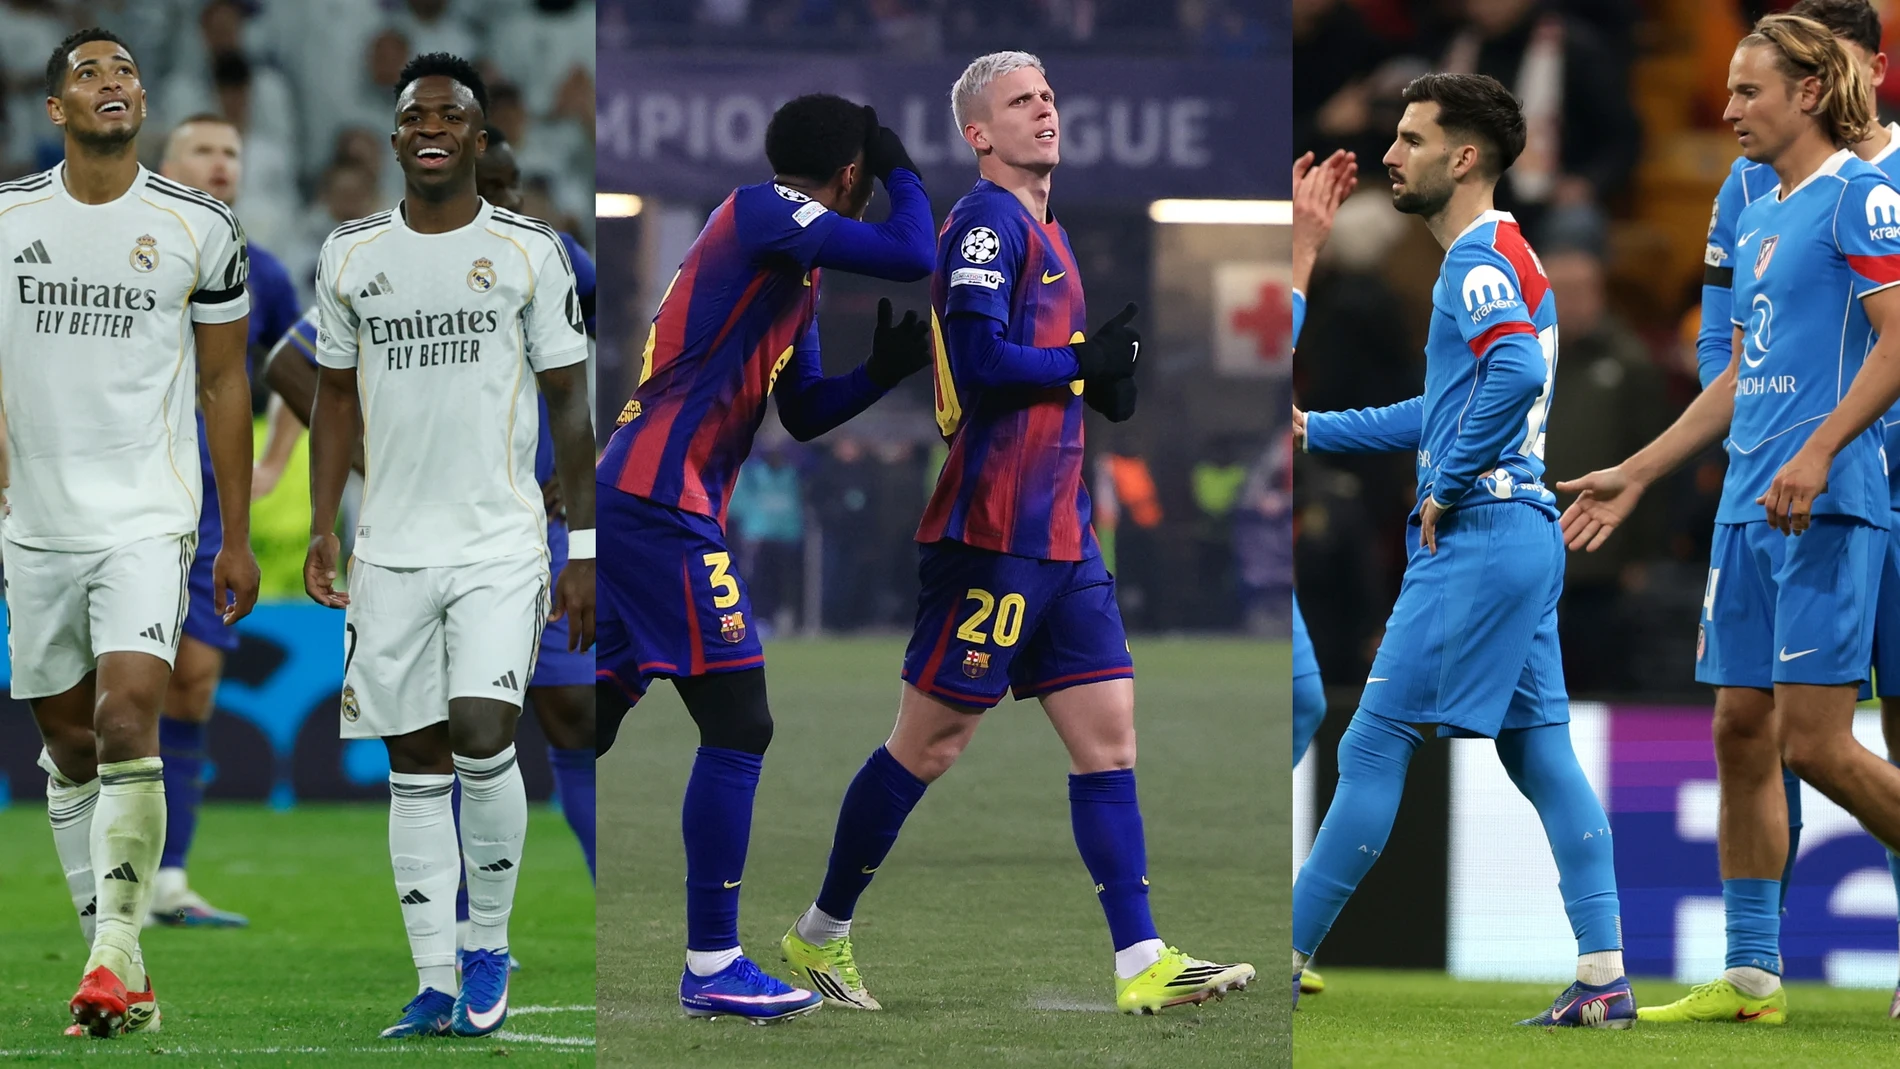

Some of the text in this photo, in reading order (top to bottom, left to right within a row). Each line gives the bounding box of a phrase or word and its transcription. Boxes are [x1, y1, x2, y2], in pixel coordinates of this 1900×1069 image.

[904, 100, 1212, 169] LGUE
[17, 275, 157, 311] Emirates
[36, 310, 134, 339] FLY BETTER
[365, 307, 498, 345] Emirates
[387, 339, 480, 371] FLY BETTER
[1766, 374, 1796, 394] AIR
[703, 551, 740, 609] 3
[956, 588, 1026, 647] 20
